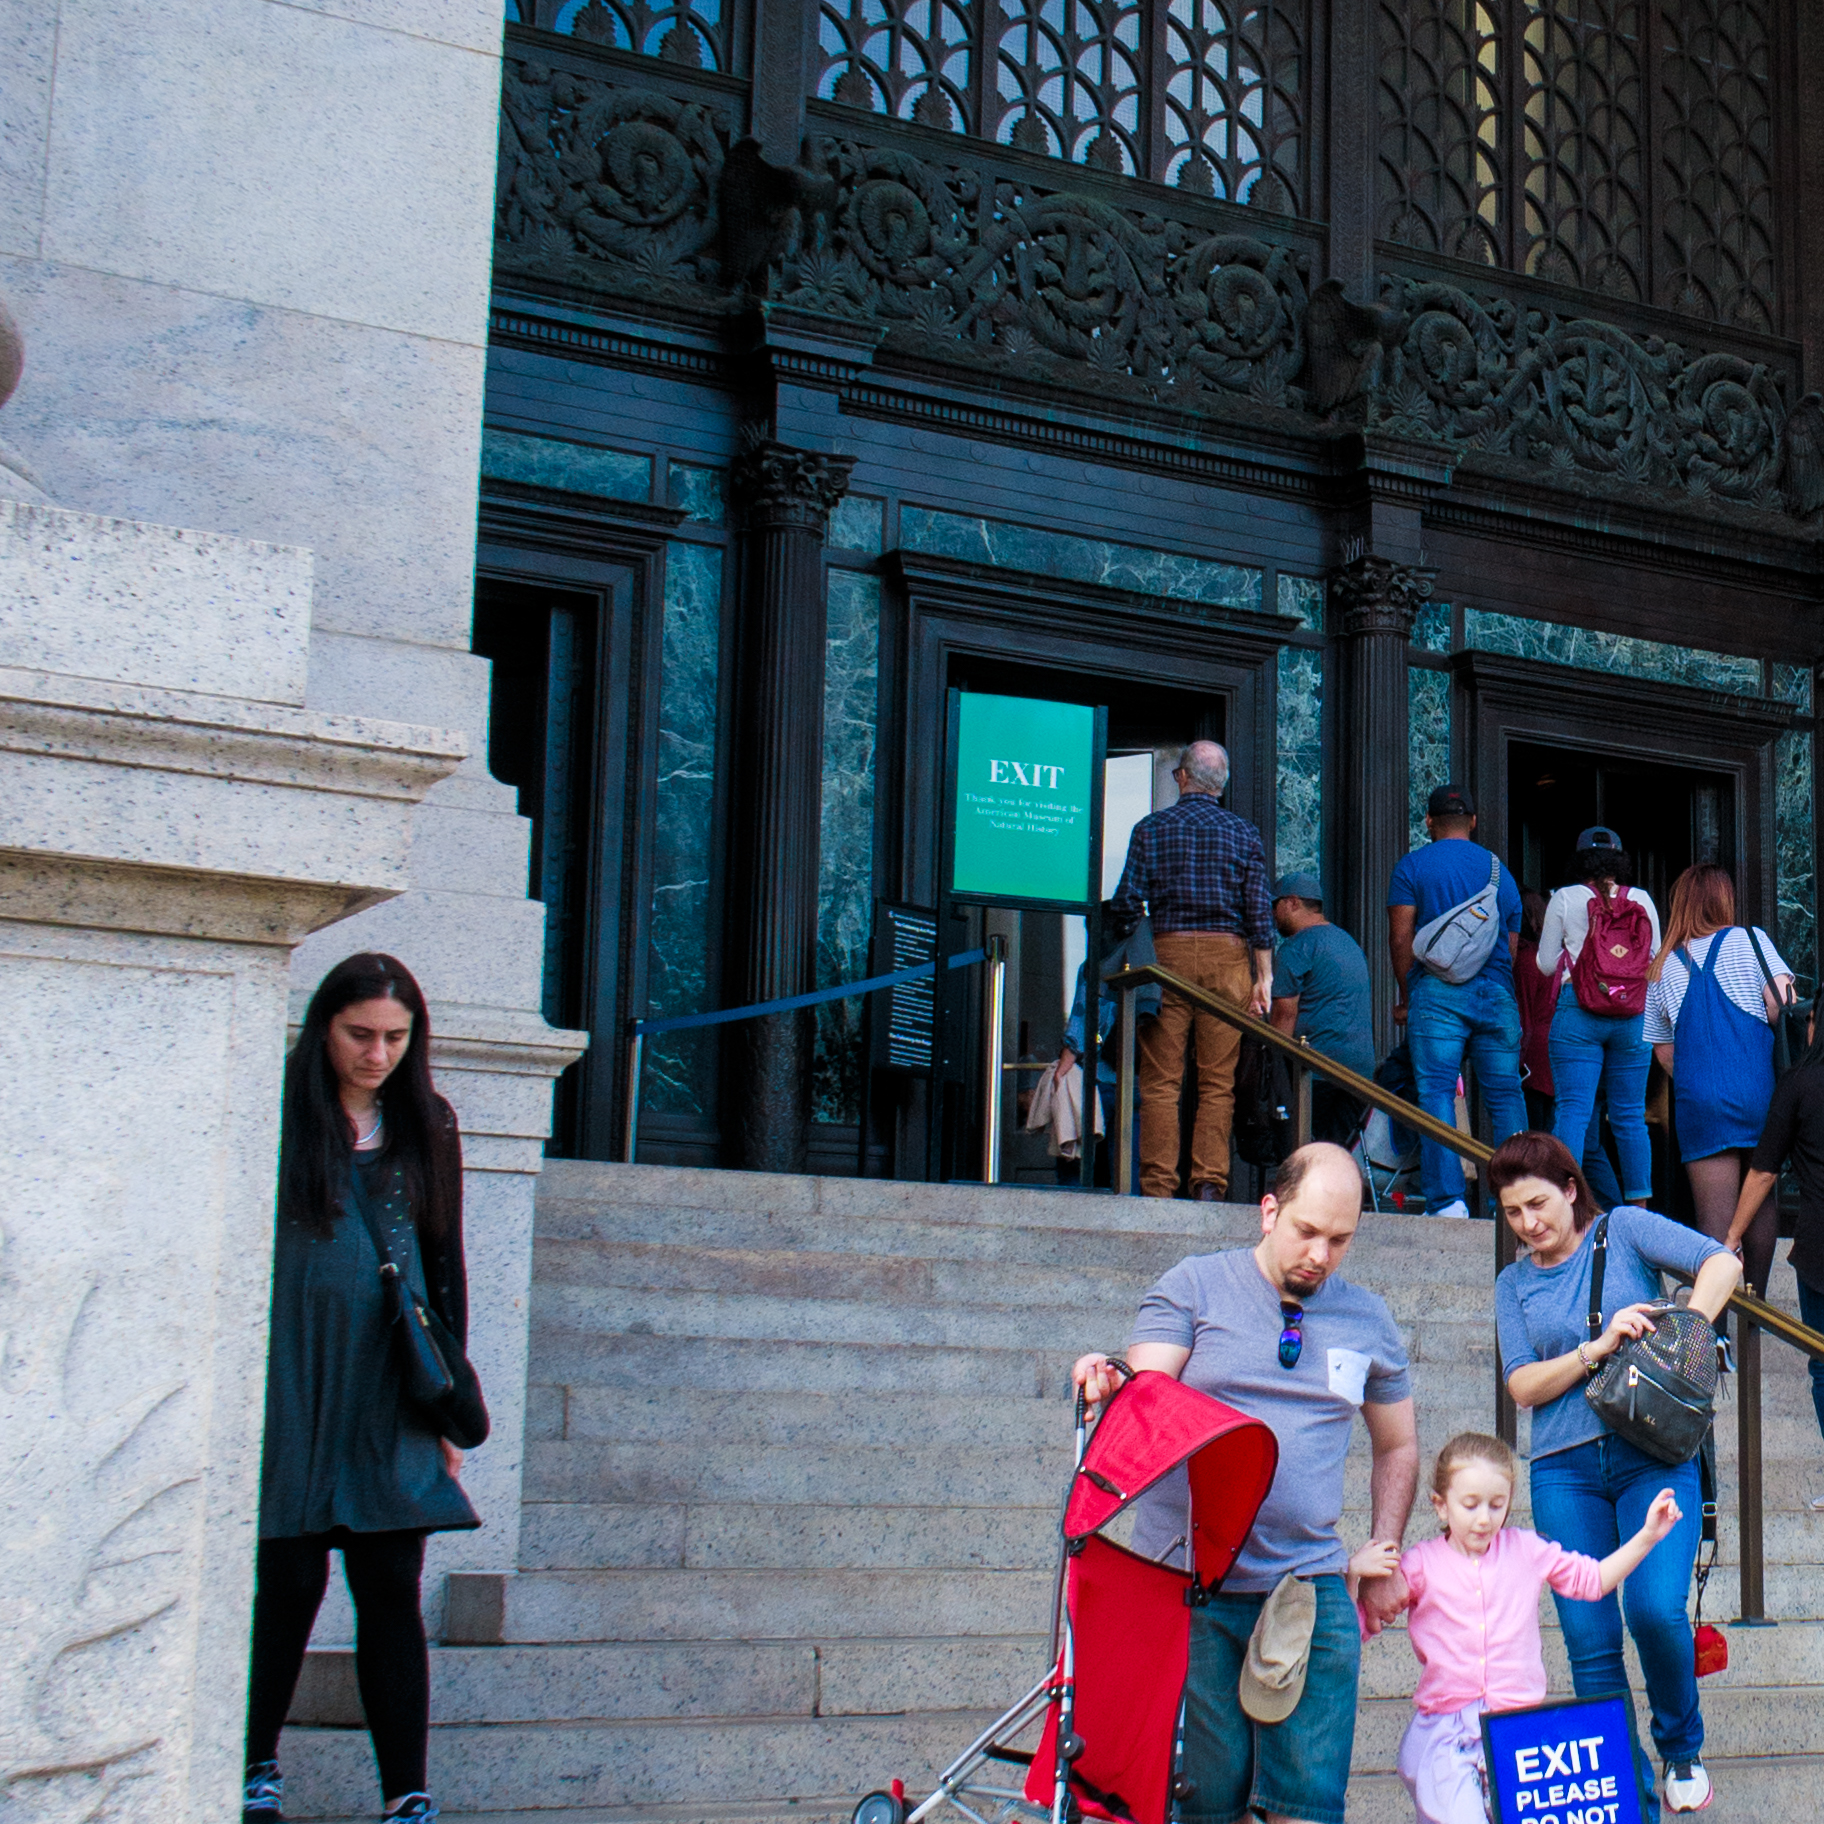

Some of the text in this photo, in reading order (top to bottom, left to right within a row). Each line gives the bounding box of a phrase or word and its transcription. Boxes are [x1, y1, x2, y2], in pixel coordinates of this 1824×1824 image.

[989, 759, 1064, 788] EXIT
[965, 792, 994, 804] Thank
[999, 798, 1015, 808] you
[1018, 799, 1031, 808] for
[1069, 803, 1084, 815] the
[976, 806, 1074, 825] American Museum of
[991, 819, 1060, 837] Natural History
[1515, 1736, 1604, 1783] EXIT
[1516, 1776, 1618, 1812] PLEASE
